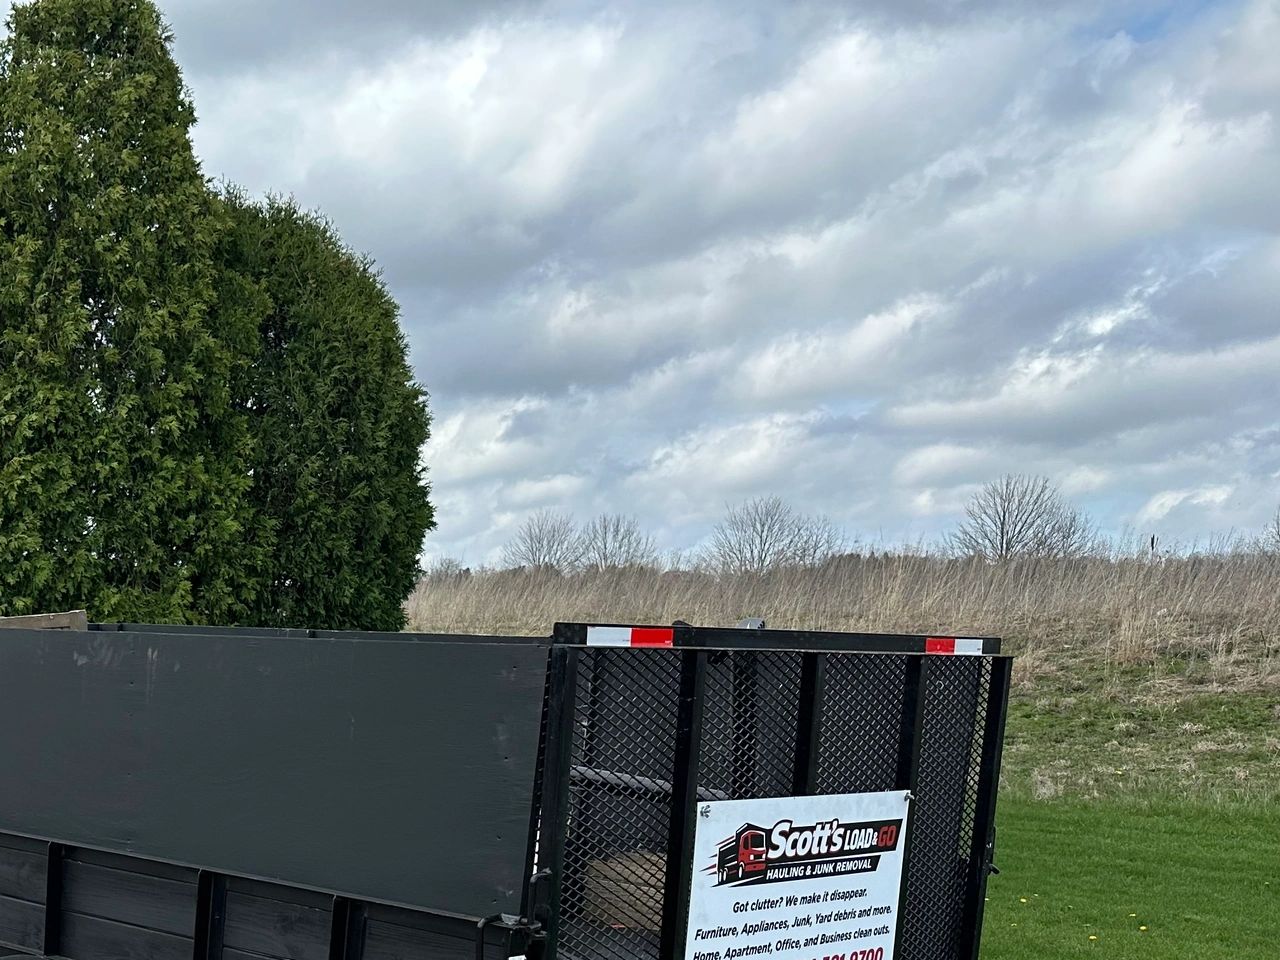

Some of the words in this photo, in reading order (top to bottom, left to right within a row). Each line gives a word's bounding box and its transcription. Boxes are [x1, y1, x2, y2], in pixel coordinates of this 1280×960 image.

[767, 819, 844, 859] Scott's
[766, 866, 805, 880] HAULING
[805, 866, 813, 876] &
[812, 861, 834, 876] JUNK
[835, 858, 872, 873] REMOVAL
[732, 901, 750, 914] Got
[750, 896, 784, 912] clutter?
[785, 895, 799, 907] We
[799, 892, 822, 905] make
[822, 890, 829, 902] it
[829, 888, 868, 902] disappear.
[694, 926, 739, 941] Furniture,
[740, 919, 790, 936] Appliances,
[791, 914, 813, 928] Junk,
[815, 911, 834, 925] Yard
[833, 908, 857, 921] debris
[857, 905, 872, 918] and
[872, 904, 892, 916] more.
[723, 941, 773, 960] Apartment,
[775, 937, 802, 952] Office,
[803, 933, 820, 948] and
[819, 931, 853, 944] Business
[853, 928, 872, 939] clean
[873, 924, 890, 936] outs.
